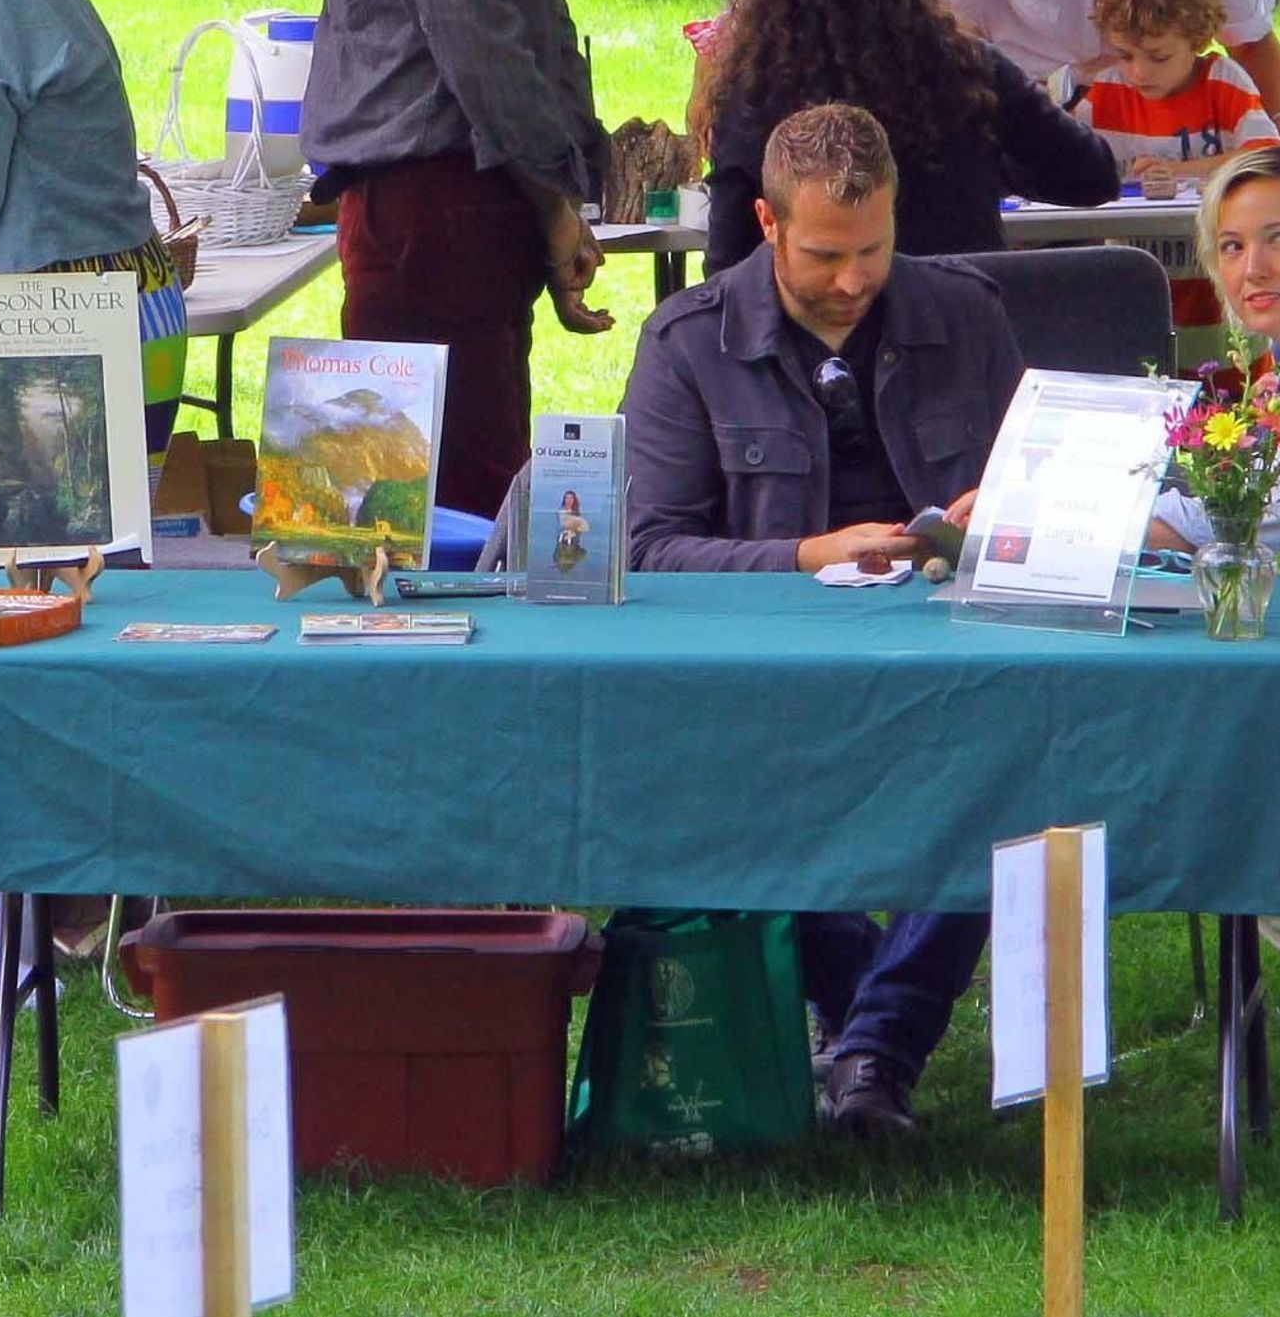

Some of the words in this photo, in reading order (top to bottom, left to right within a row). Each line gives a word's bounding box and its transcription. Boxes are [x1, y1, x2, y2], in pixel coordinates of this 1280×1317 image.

[20, 281, 43, 293] THE
[52, 286, 125, 311] RIVER
[281, 347, 362, 375] Thomas
[369, 353, 414, 377] Cole
[548, 447, 572, 458] Land
[582, 448, 608, 459] Local
